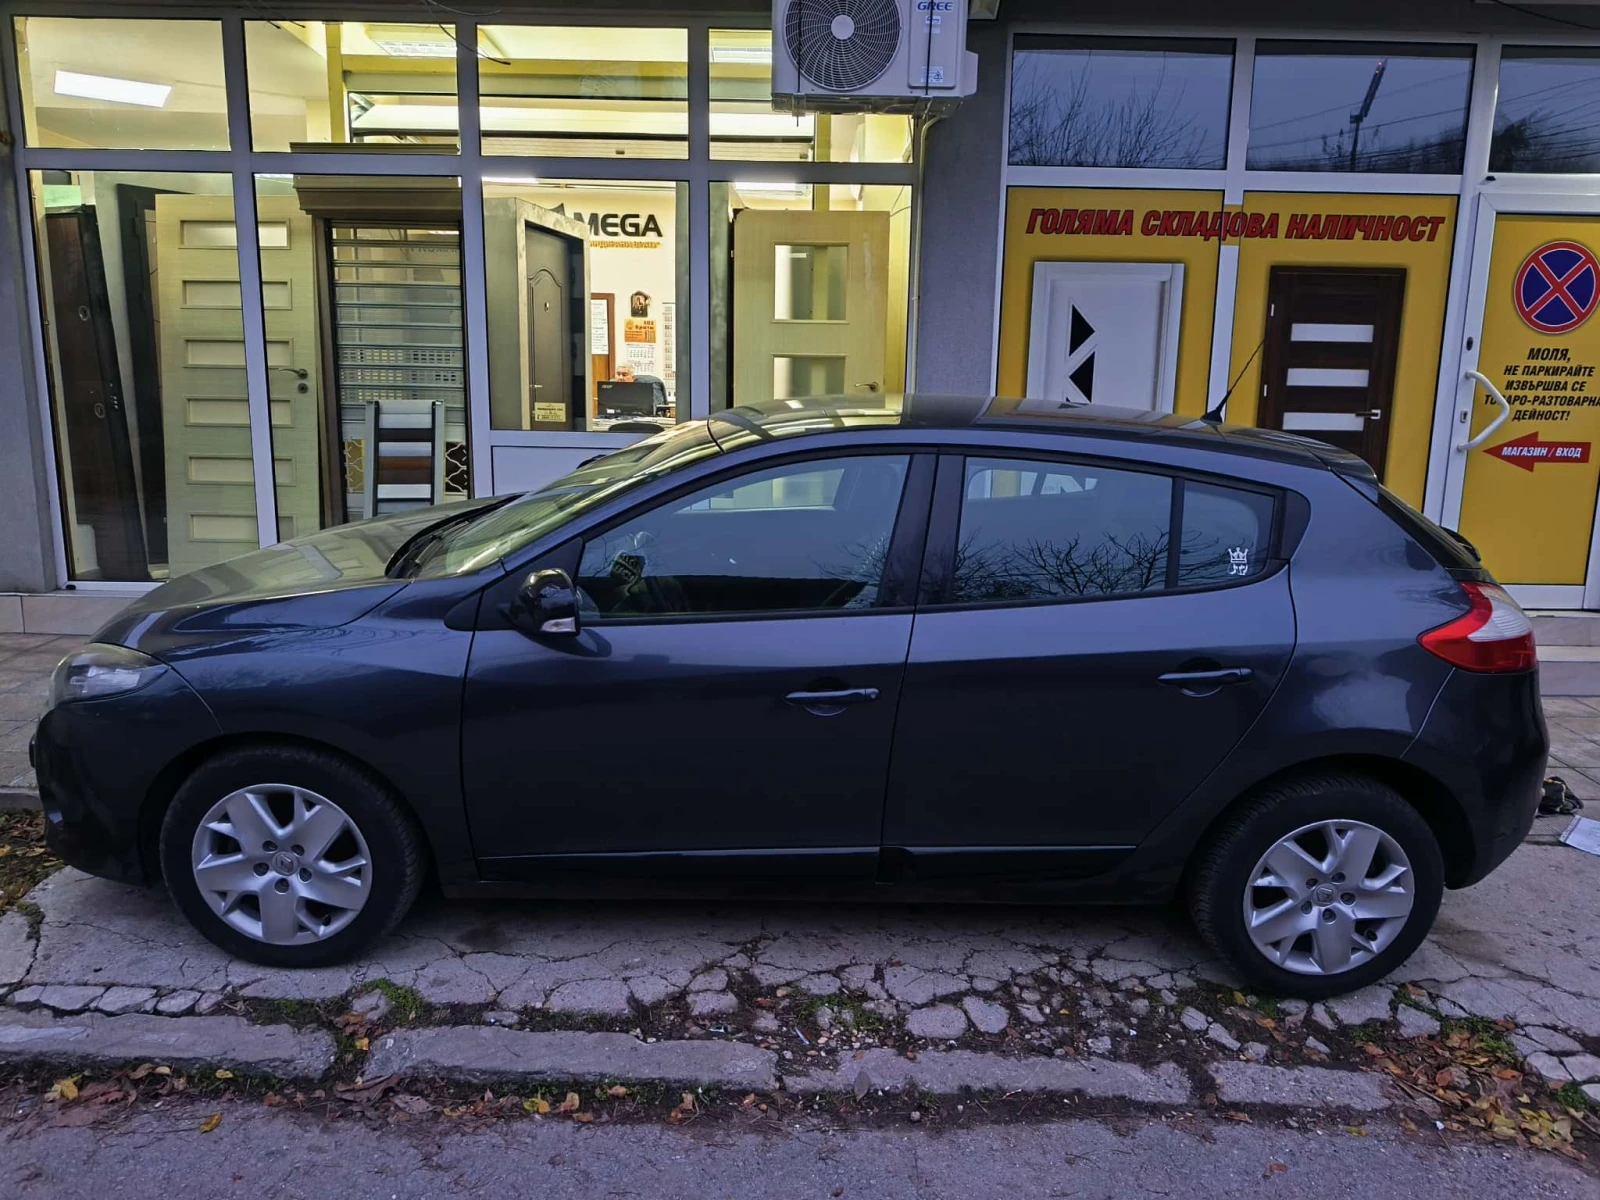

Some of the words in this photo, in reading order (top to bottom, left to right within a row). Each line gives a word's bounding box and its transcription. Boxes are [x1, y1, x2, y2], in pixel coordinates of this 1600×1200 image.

[917, 1, 954, 11] GREE
[1026, 208, 1133, 236] ГОЛЯМА
[1141, 210, 1279, 241] СКЛАДОВА
[1285, 213, 1445, 242] НАЛИЧНОСТ
[1527, 348, 1571, 362] МОЛЯ,
[1503, 365, 1519, 376] НЕ
[1521, 364, 1595, 377] ПАРКИРАЙТЕ
[1505, 381, 1569, 392] ИЗВЪРШВА
[1571, 381, 1586, 392] СЕ
[1512, 409, 1570, 422] ДЕЙНОСТ!
[1501, 446, 1548, 457] МАГАЗИН
[1555, 447, 1582, 458] ВХОД
